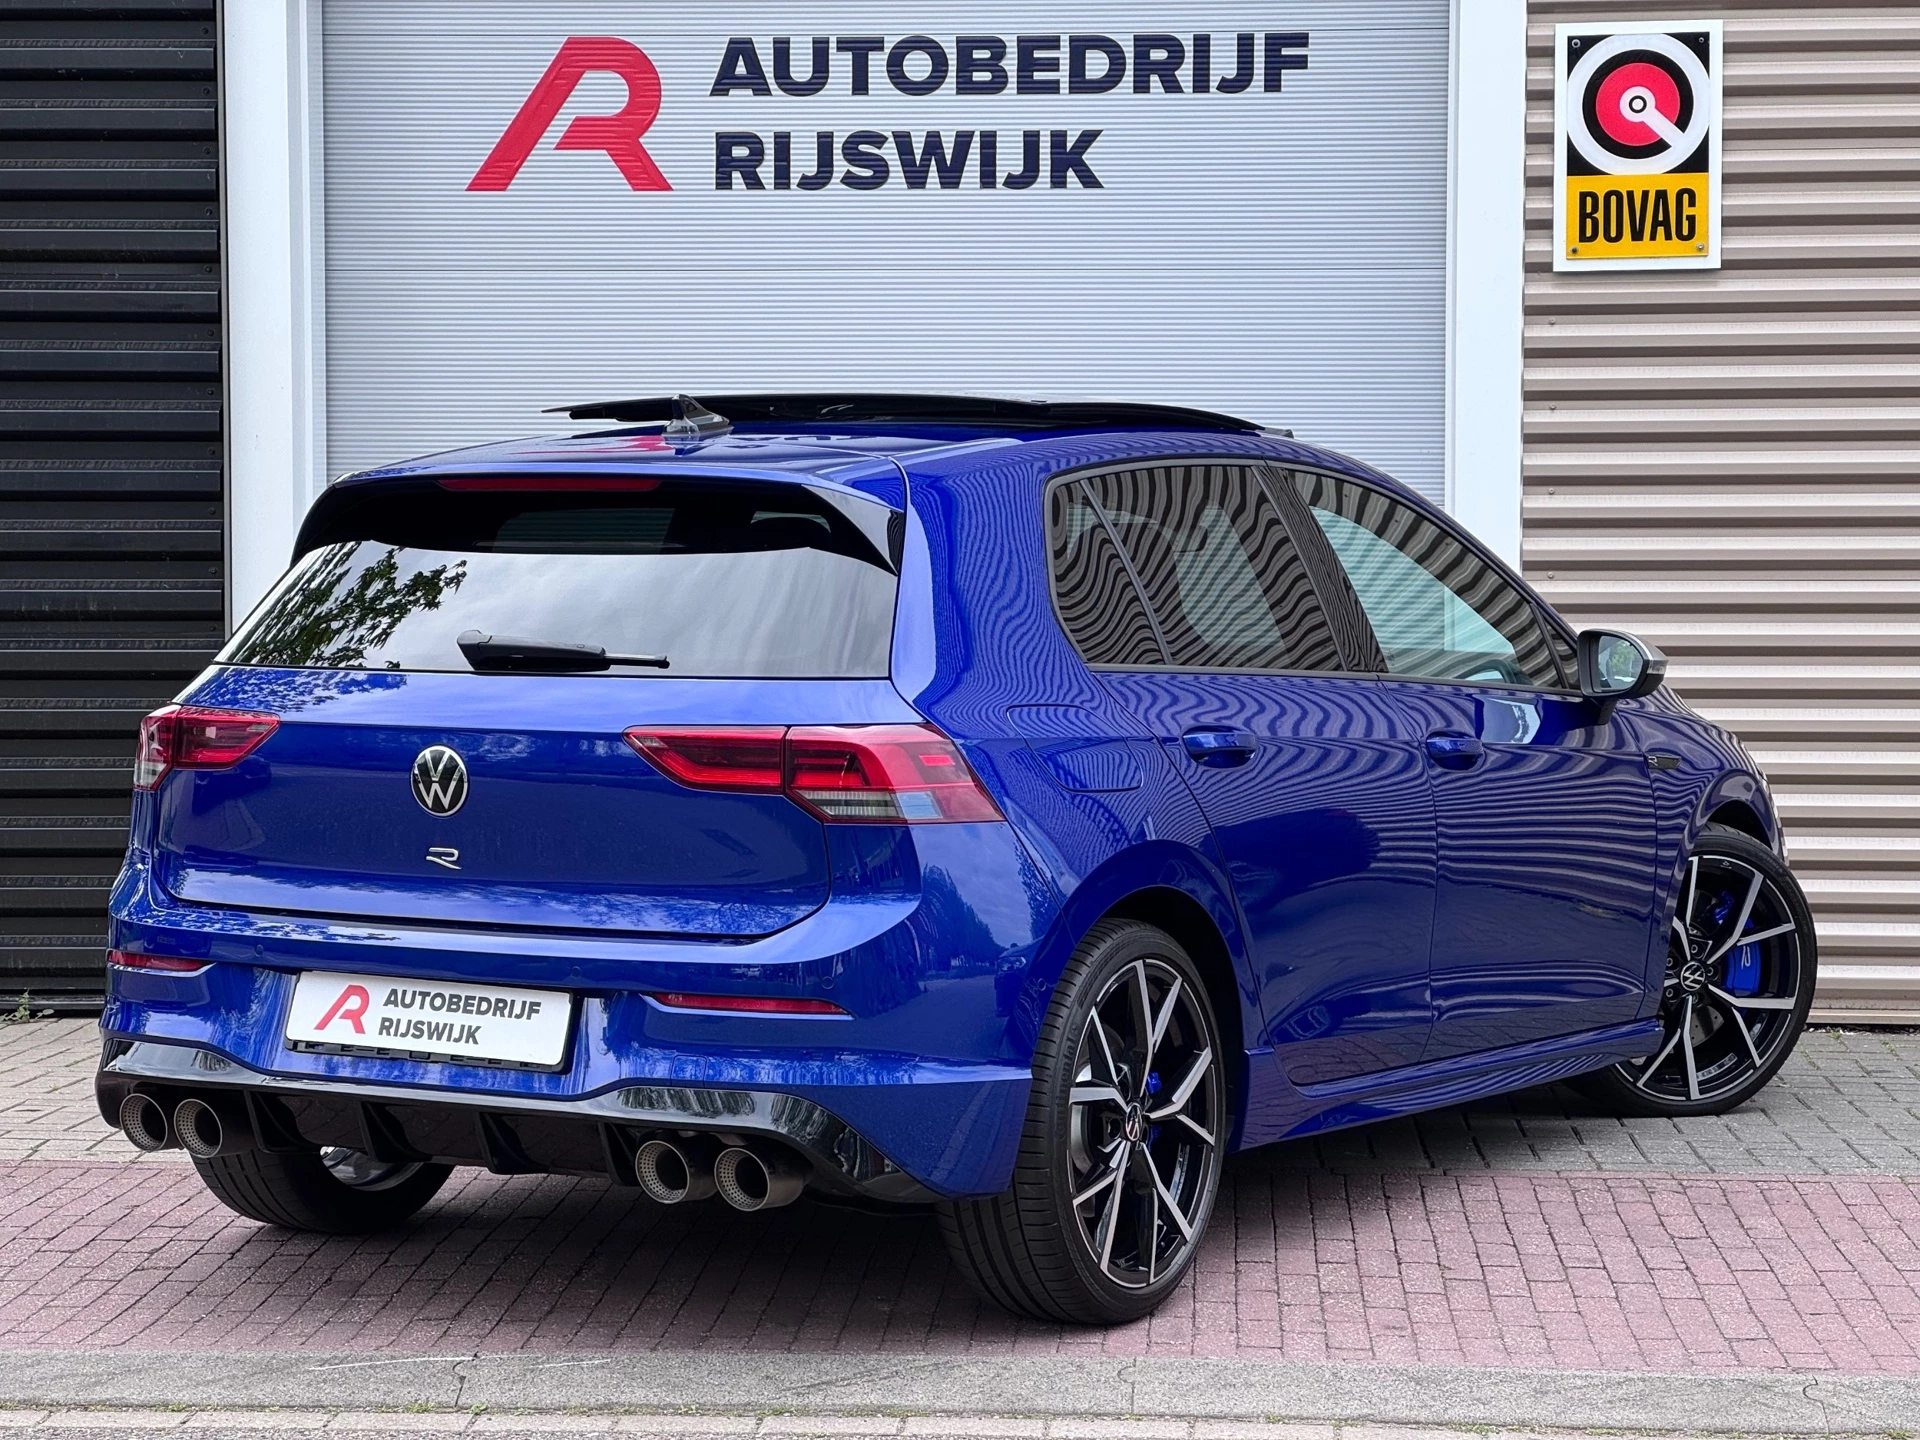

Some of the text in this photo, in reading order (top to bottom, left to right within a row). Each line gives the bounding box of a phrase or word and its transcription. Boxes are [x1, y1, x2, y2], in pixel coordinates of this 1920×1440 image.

[709, 32, 1311, 98] AUTOBEDRIJF
[715, 129, 1105, 192] RIJSWIJK
[1578, 187, 1697, 243] BOVAG
[377, 1016, 482, 1045] RIJSWIJK
[382, 988, 542, 1021] AUTOBEDRIJF
